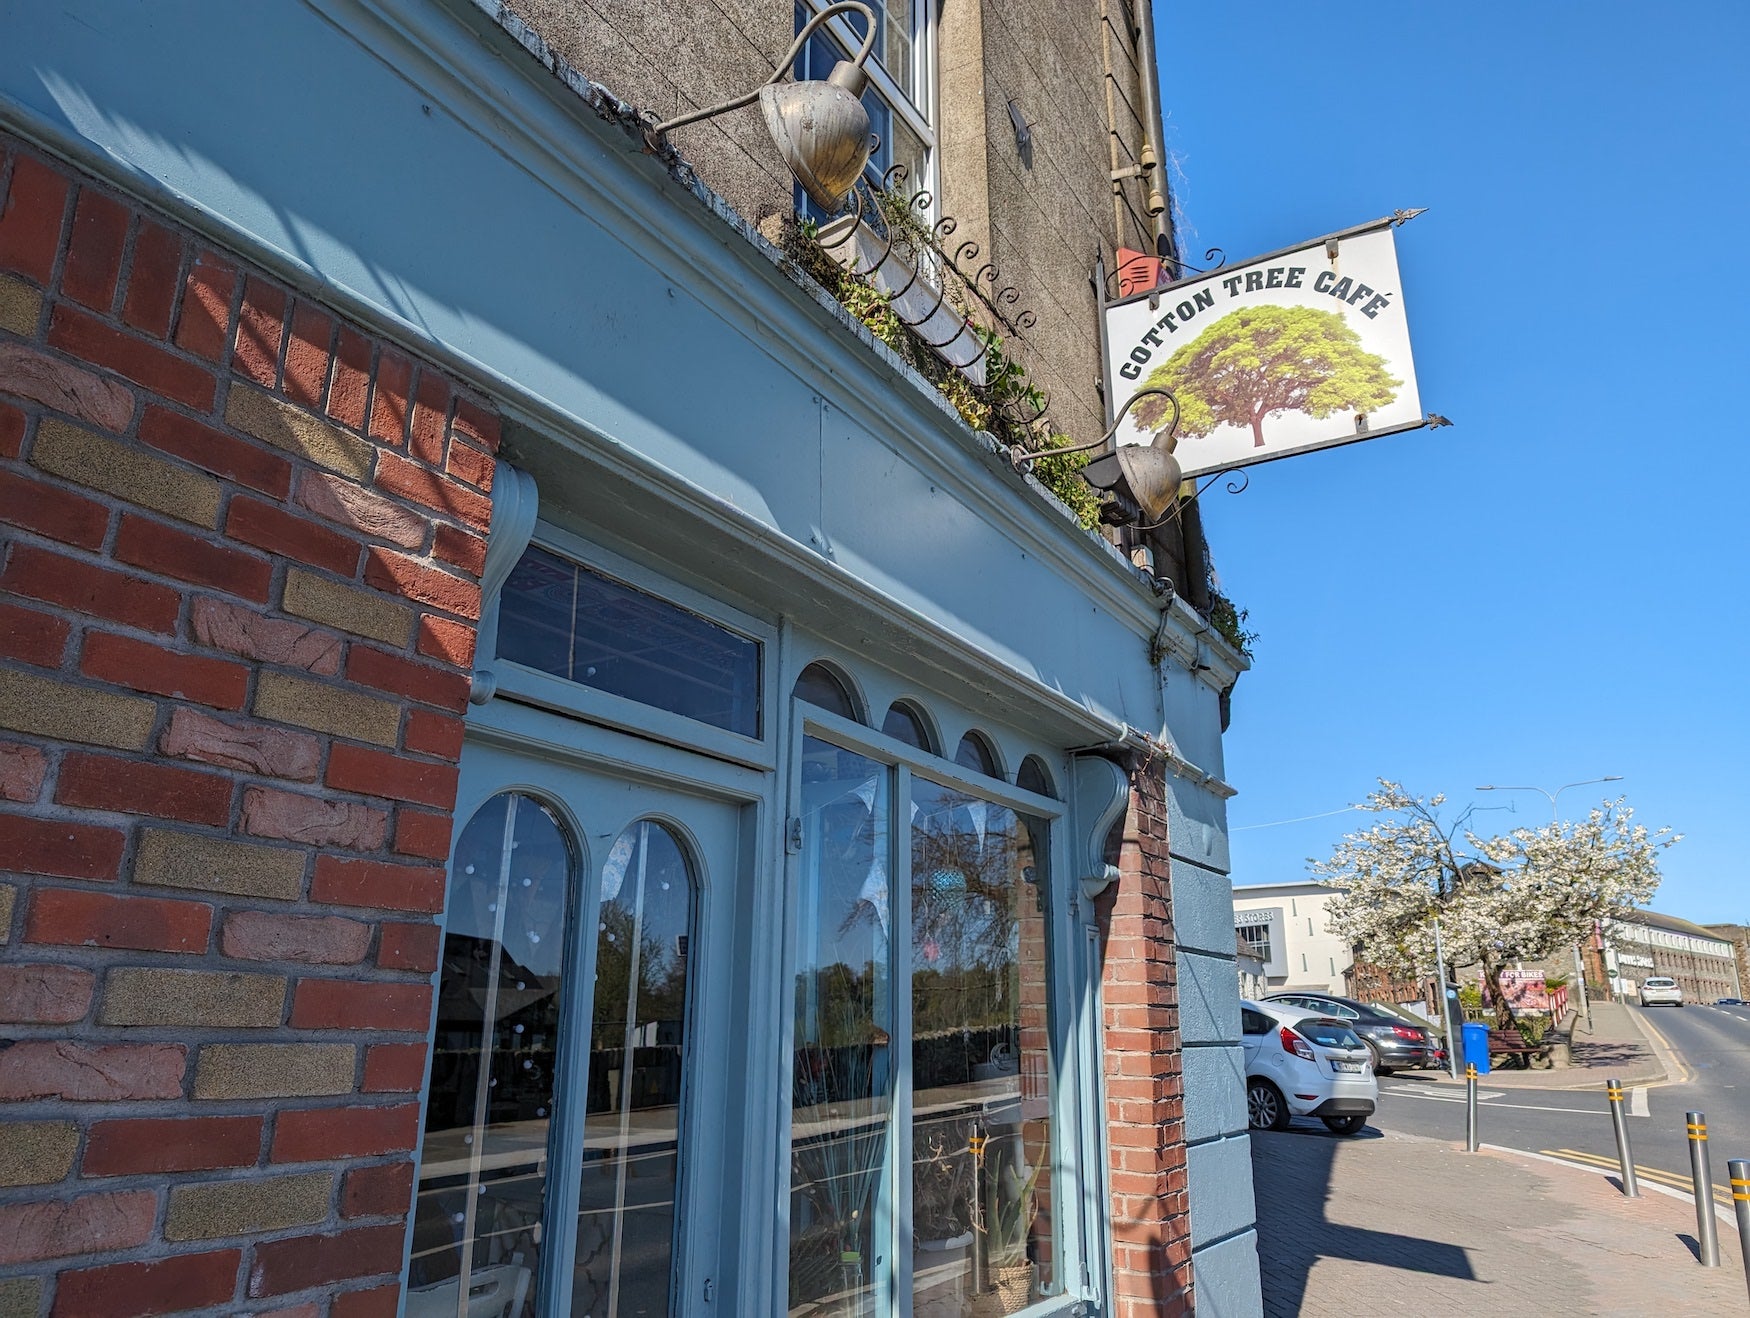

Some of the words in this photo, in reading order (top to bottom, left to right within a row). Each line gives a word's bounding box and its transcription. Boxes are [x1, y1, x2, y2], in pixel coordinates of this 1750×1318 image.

[1119, 287, 1215, 381] COTTON
[1223, 267, 1307, 299] TREE
[1313, 270, 1392, 320] CAFÉ
[1244, 911, 1274, 923] STORES
